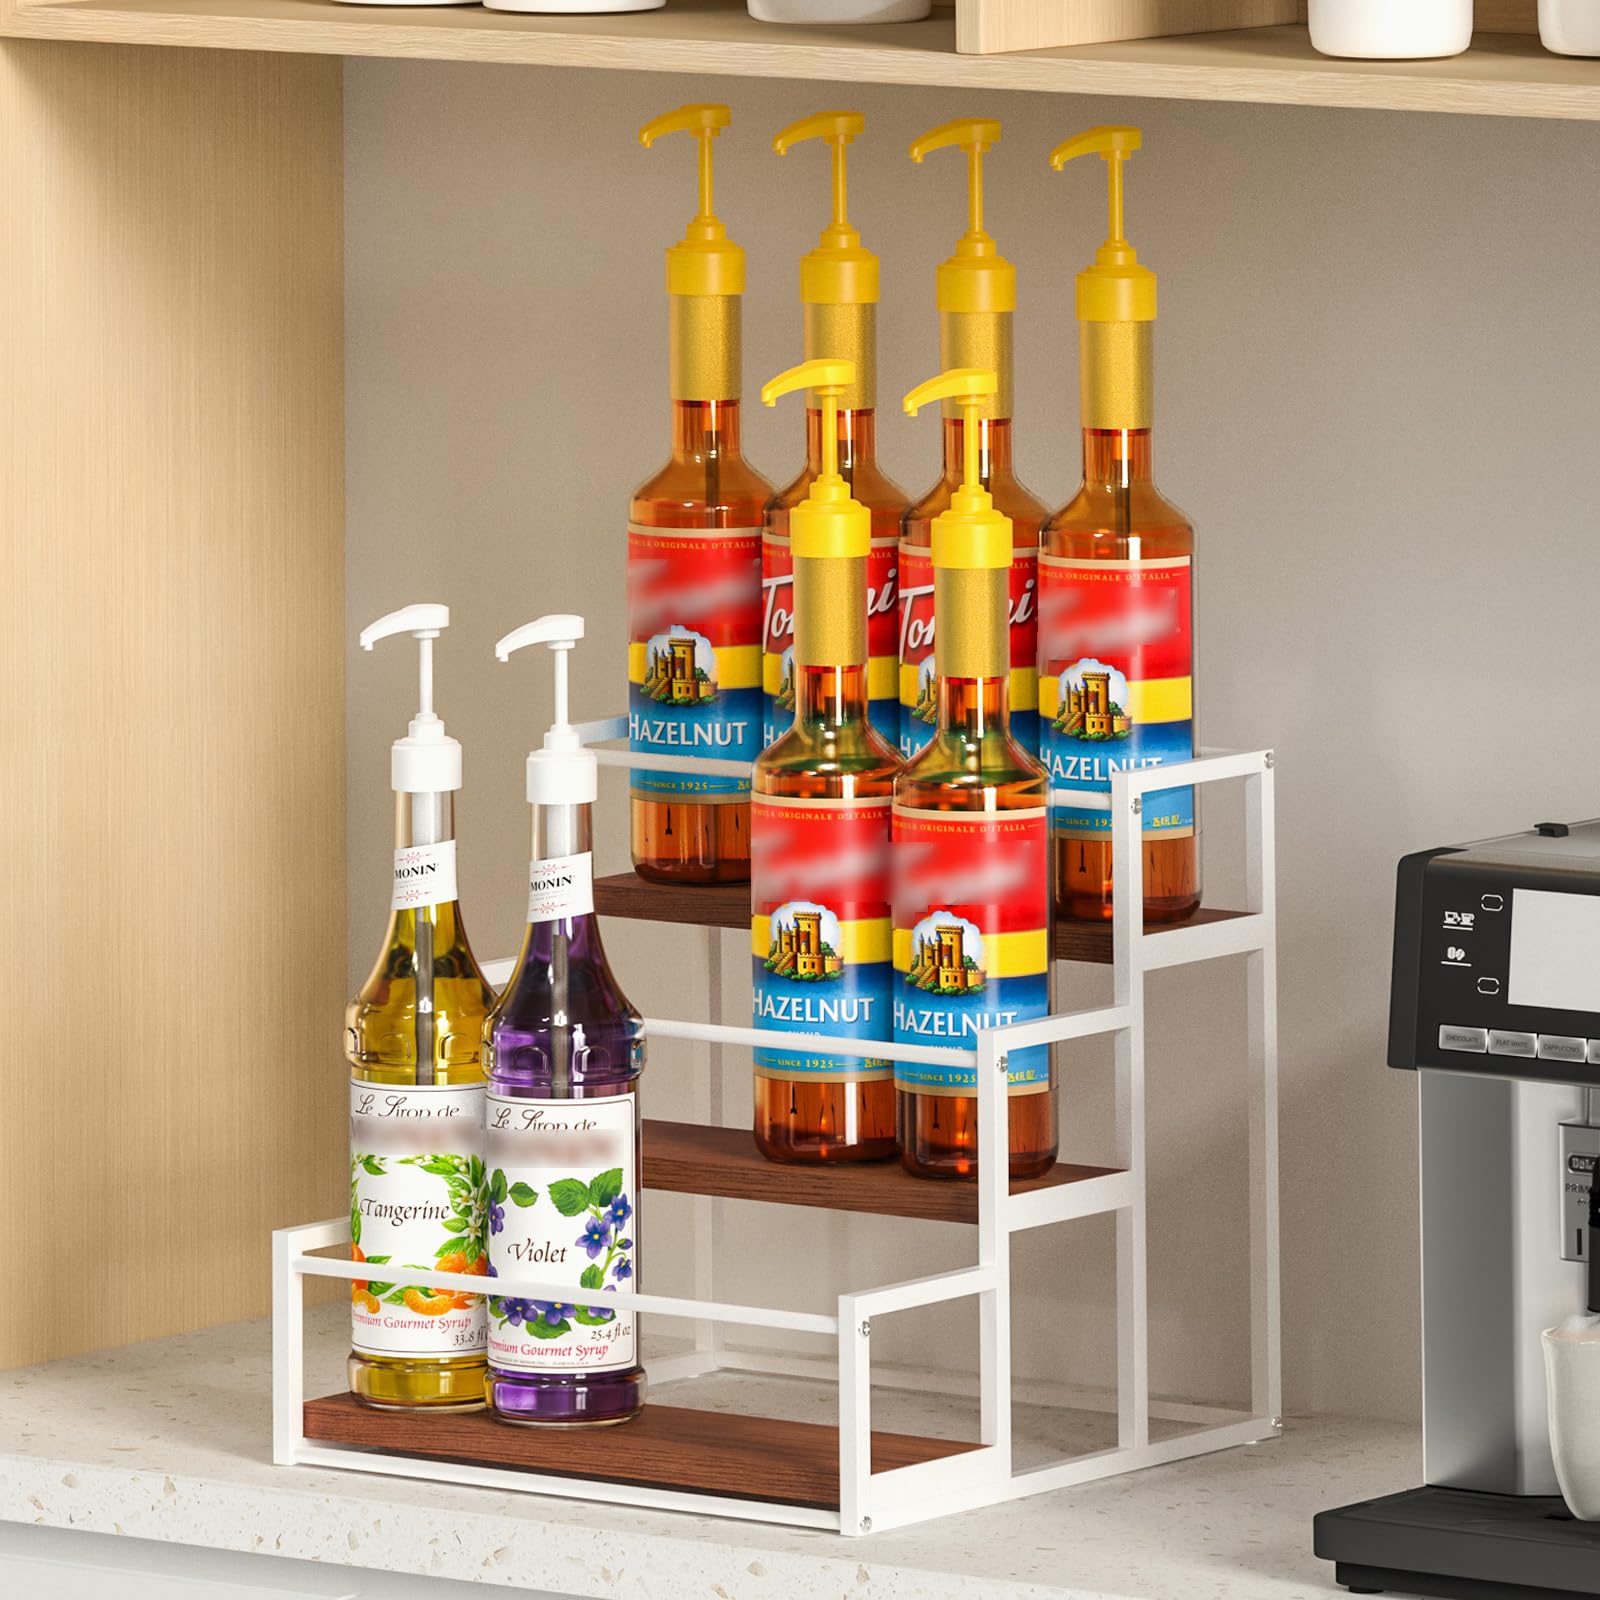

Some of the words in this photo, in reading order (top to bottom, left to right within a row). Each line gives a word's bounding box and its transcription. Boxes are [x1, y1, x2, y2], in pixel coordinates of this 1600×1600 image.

[655, 541, 705, 550] ORIGINALE
[711, 541, 756, 550] D'ITALIA
[1065, 571, 1121, 582] ORIGINALE
[628, 711, 748, 746] HAZELNUT
[681, 781, 708, 790] 1925
[777, 810, 833, 820] ORIGINALE
[919, 823, 976, 833] ORIGINALE
[395, 863, 437, 879] MONIN
[530, 875, 573, 892] MONIN
[753, 986, 875, 1023] HAZELNUT
[805, 1059, 834, 1069] 1925
[948, 1073, 977, 1084] 1925
[355, 1094, 375, 1115] Le
[437, 1105, 460, 1117] de
[491, 1107, 511, 1129] Le
[360, 1198, 450, 1227] Tangerine
[507, 1237, 568, 1263] Violet
[383, 1316, 435, 1329] Gourmet
[438, 1316, 472, 1334] Syrup
[591, 1329, 612, 1341] 25.4
[622, 1325, 631, 1336] oz
[453, 1331, 475, 1346] 33.8
[520, 1343, 572, 1356] Gourmet
[575, 1344, 609, 1361] Syrup
